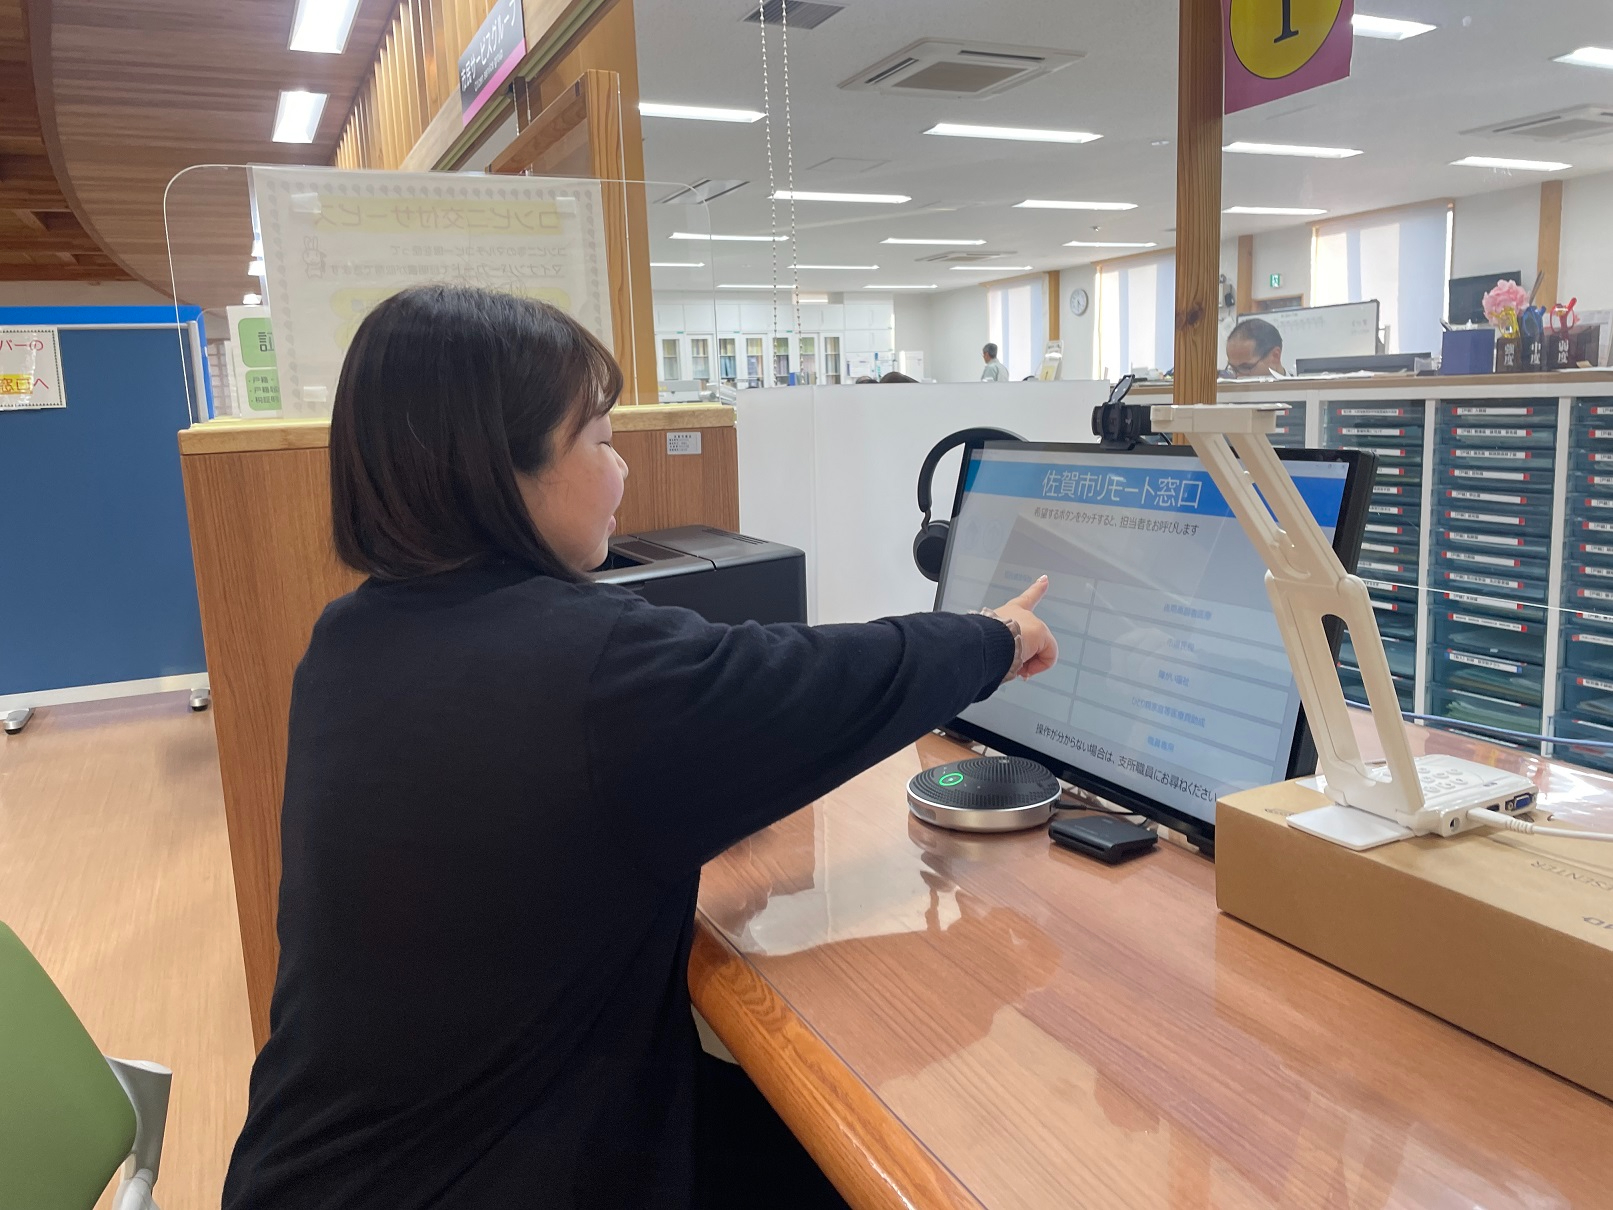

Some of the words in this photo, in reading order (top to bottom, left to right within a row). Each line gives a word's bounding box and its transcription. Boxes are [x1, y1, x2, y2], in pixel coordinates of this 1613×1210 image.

[1042, 470, 1203, 509] 佐賀市リモート窓口
[1034, 507, 1199, 536] 希望するボタンをタッチすると、担当者をお呼びします
